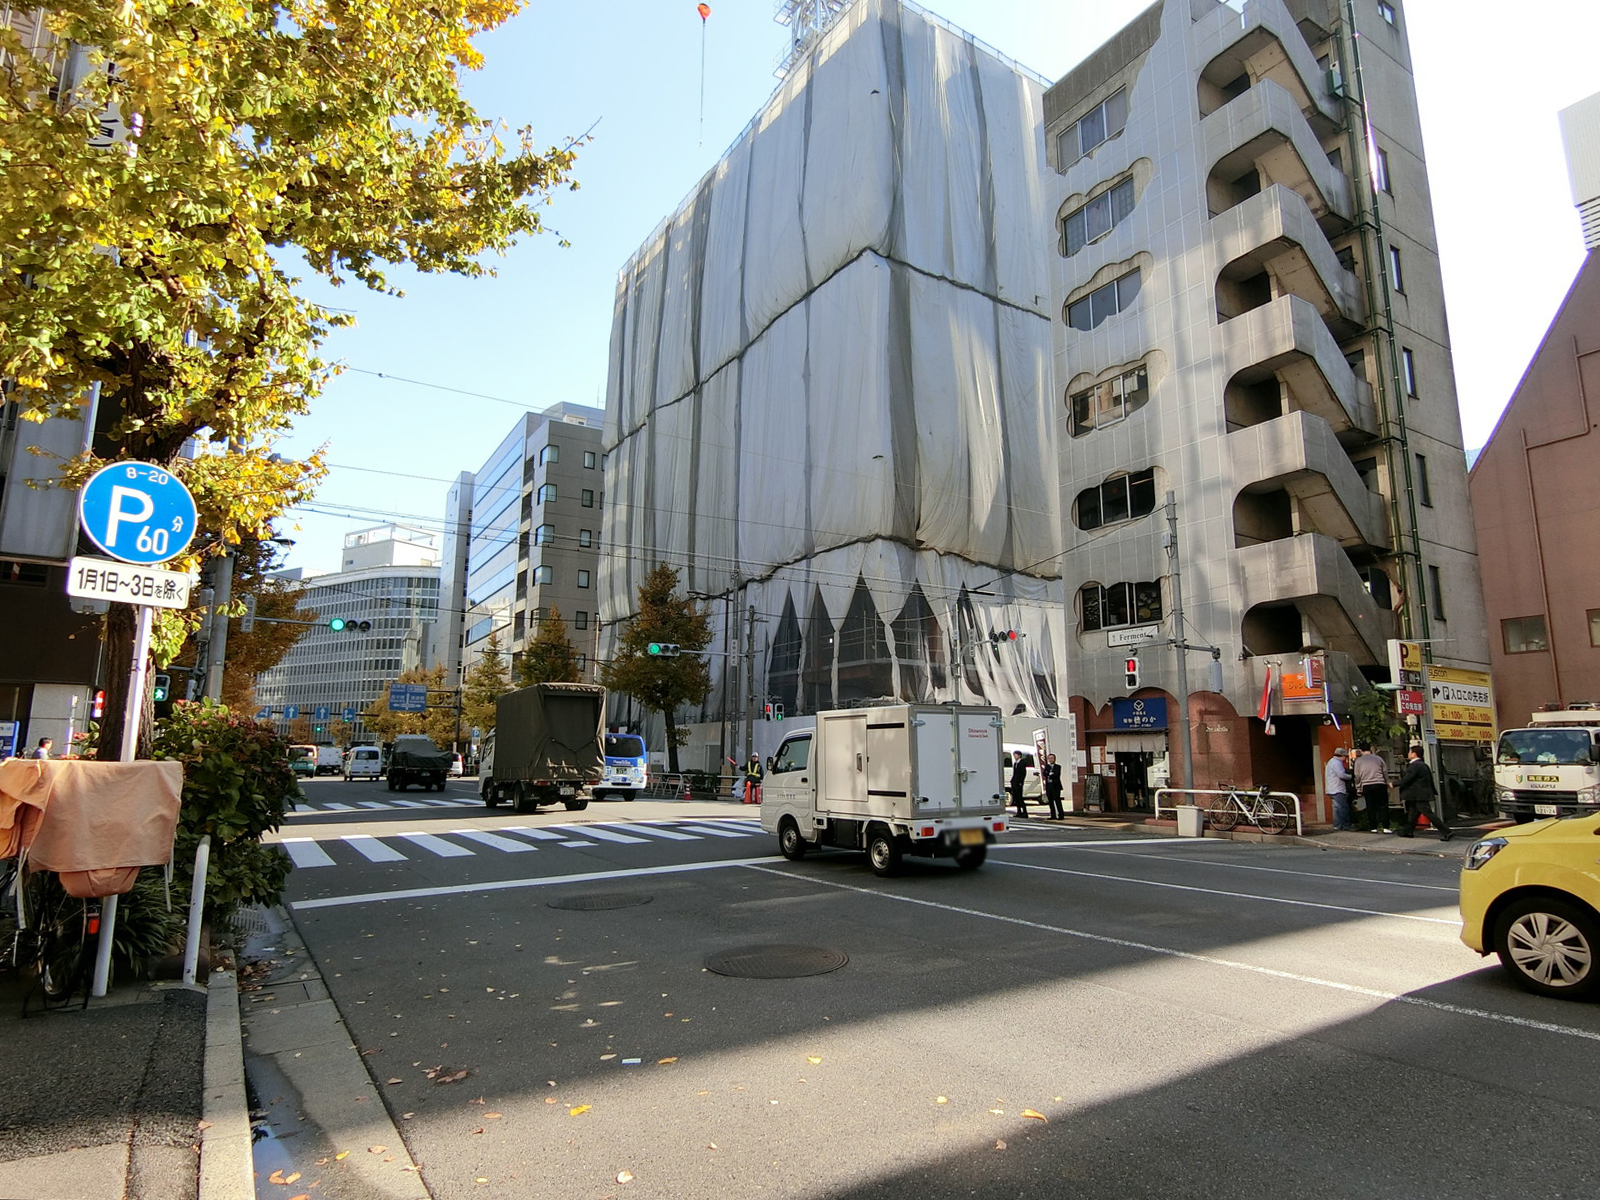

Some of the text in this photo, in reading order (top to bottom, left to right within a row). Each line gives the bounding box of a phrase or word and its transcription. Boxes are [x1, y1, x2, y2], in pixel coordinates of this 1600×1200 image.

[125, 466, 169, 485] 8-20
[105, 484, 154, 548] P
[171, 516, 184, 533] 分
[136, 525, 169, 556] 60
[1400, 643, 1409, 667] P
[1400, 693, 1410, 701] 入口
